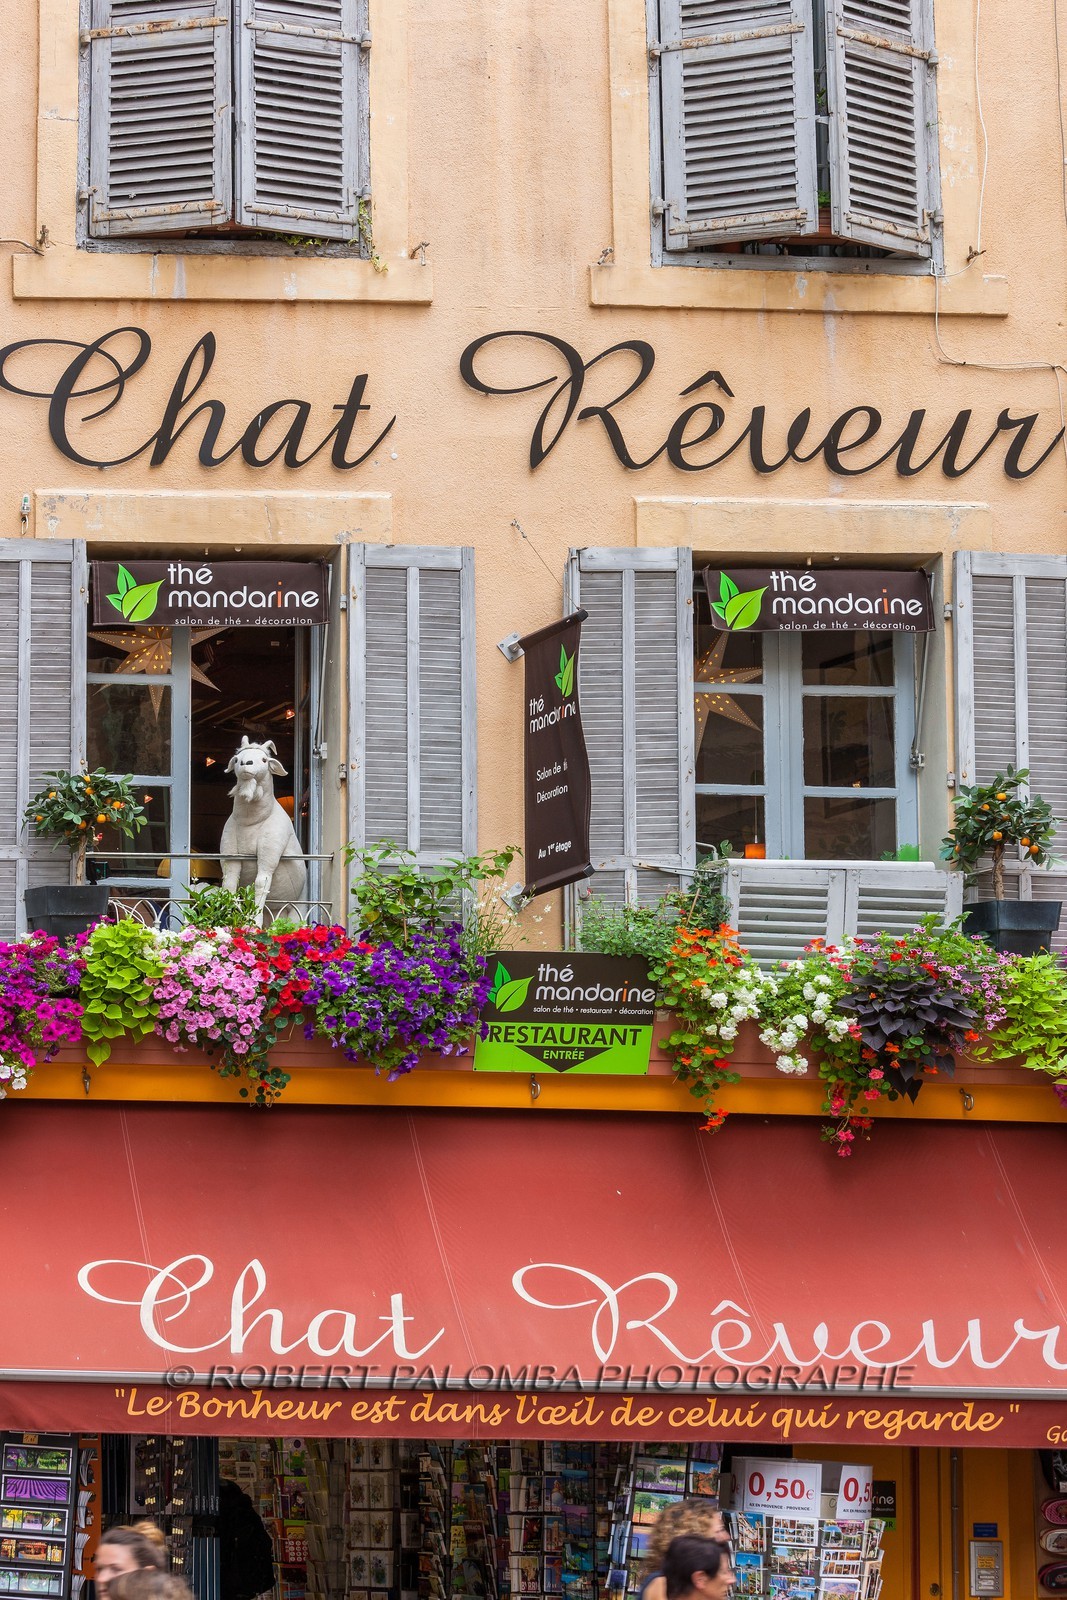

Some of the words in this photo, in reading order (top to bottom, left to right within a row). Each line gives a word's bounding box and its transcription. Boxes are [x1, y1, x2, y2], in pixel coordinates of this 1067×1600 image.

[0, 327, 397, 470] Chat
[459, 330, 1066, 478] Rêveur
[167, 563, 214, 585] thé
[769, 570, 817, 592] thé
[168, 581, 320, 608] mandarine
[772, 588, 923, 616] mandarine
[175, 616, 203, 625] salon
[207, 616, 220, 625] de
[224, 616, 242, 625] thé
[255, 616, 313, 625] décoration
[779, 621, 808, 630] salon
[812, 620, 827, 629] de
[831, 620, 849, 629] thé
[862, 619, 916, 631] décoration
[529, 694, 545, 716] thé
[536, 766, 552, 782] Salon
[552, 761, 562, 775] de
[536, 784, 569, 804] Décoration
[538, 848, 547, 859] Au
[555, 840, 572, 853] étage
[537, 963, 575, 983] thé
[535, 980, 656, 1003] mandarine
[552, 1005, 562, 1013] de
[618, 1006, 654, 1015] décoration
[488, 1025, 643, 1046] RESTAURANT
[543, 1048, 585, 1060] ENTRÉE
[78, 1254, 445, 1360] Chat
[511, 1263, 1067, 1371] Rêveur
[176, 1389, 343, 1421] Bonheur
[351, 1395, 407, 1424] est
[409, 1393, 511, 1426] dans
[515, 1395, 604, 1427] l'œil
[610, 1397, 663, 1427] de
[667, 1397, 767, 1428] celui
[771, 1401, 840, 1438] qui
[748, 1471, 815, 1502] 0,50€
